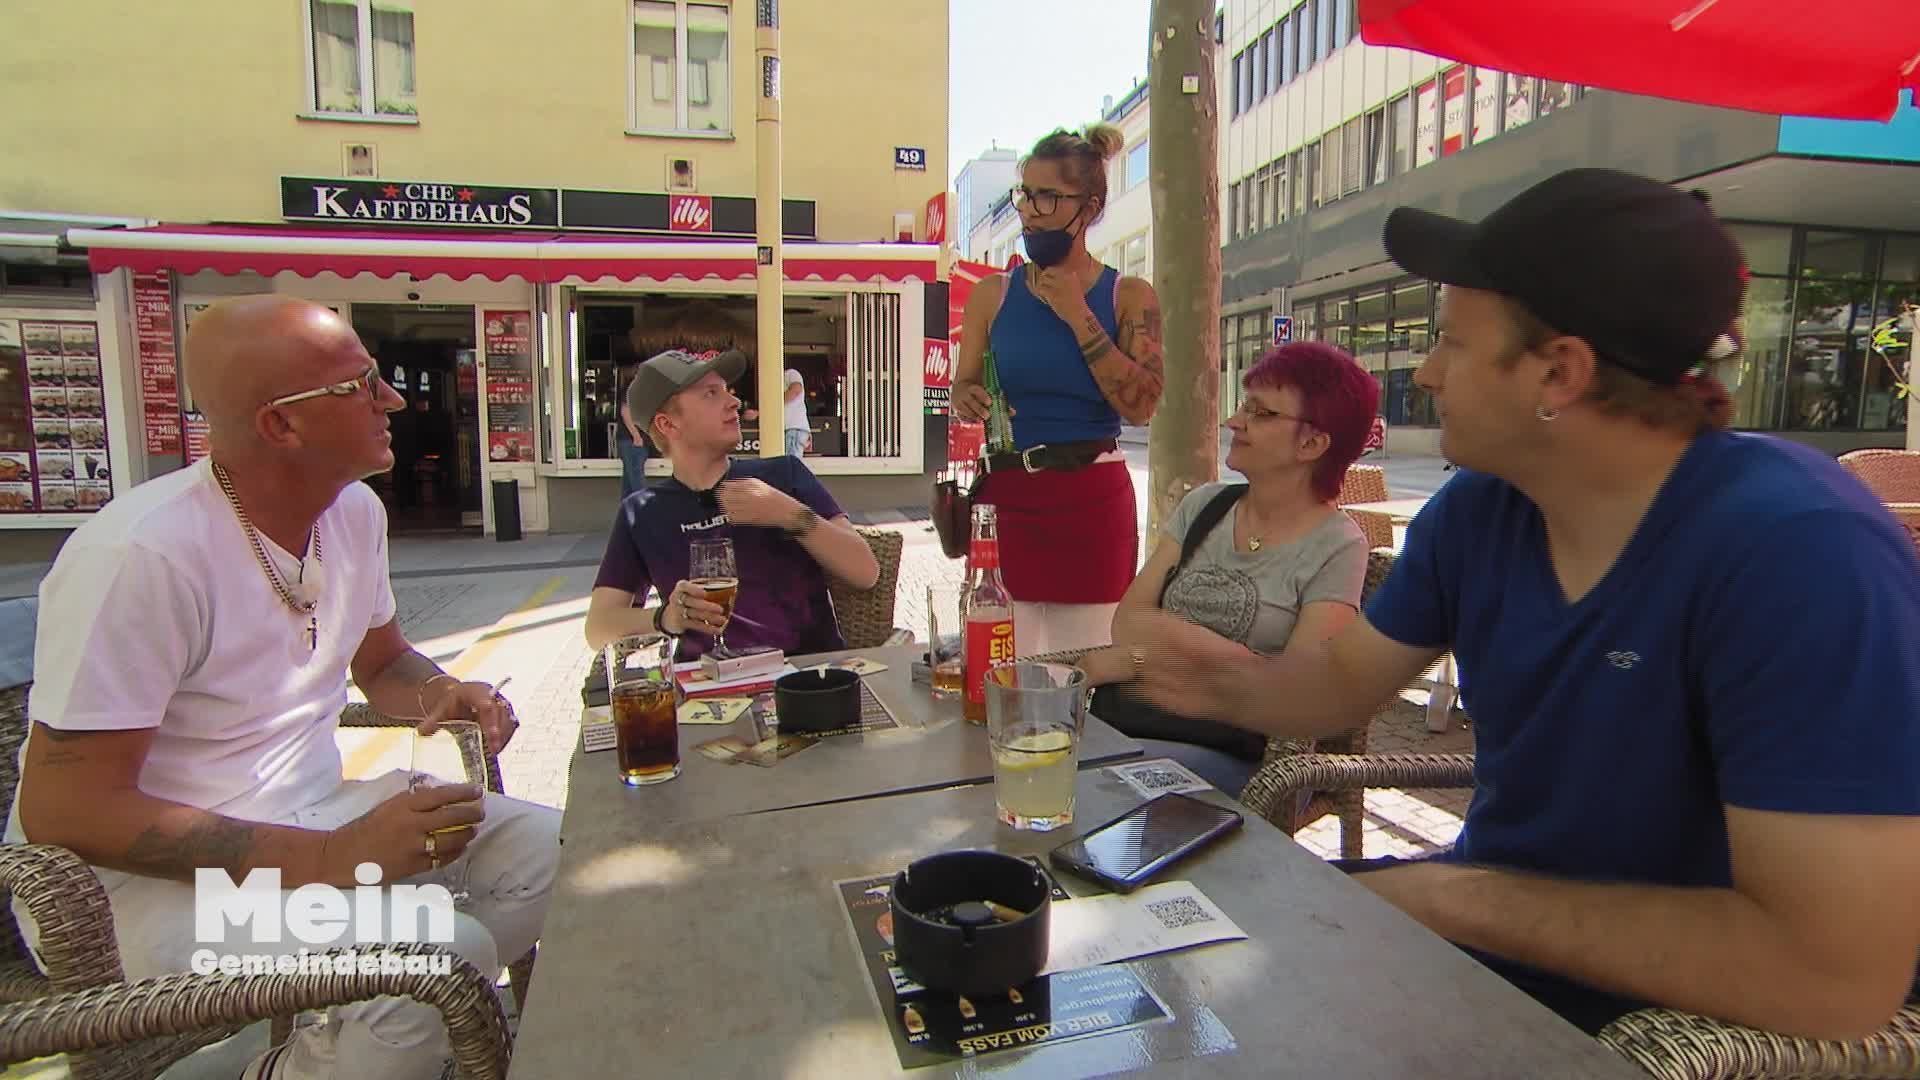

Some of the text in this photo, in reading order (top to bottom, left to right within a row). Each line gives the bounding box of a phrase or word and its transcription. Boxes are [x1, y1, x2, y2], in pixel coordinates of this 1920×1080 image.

[899, 149, 920, 163] 49
[405, 184, 454, 201] CHE
[313, 186, 532, 225] KAFFEEHAUS
[673, 198, 709, 229] illy
[148, 302, 170, 312] Milk
[154, 364, 176, 375] Milk
[925, 346, 949, 382] illy
[924, 389, 949, 399] ITALIAN
[160, 426, 180, 436] Milk
[1058, 987, 1146, 1012] Wieselburger
[959, 1012, 1112, 1053] BIER VOM FASS
